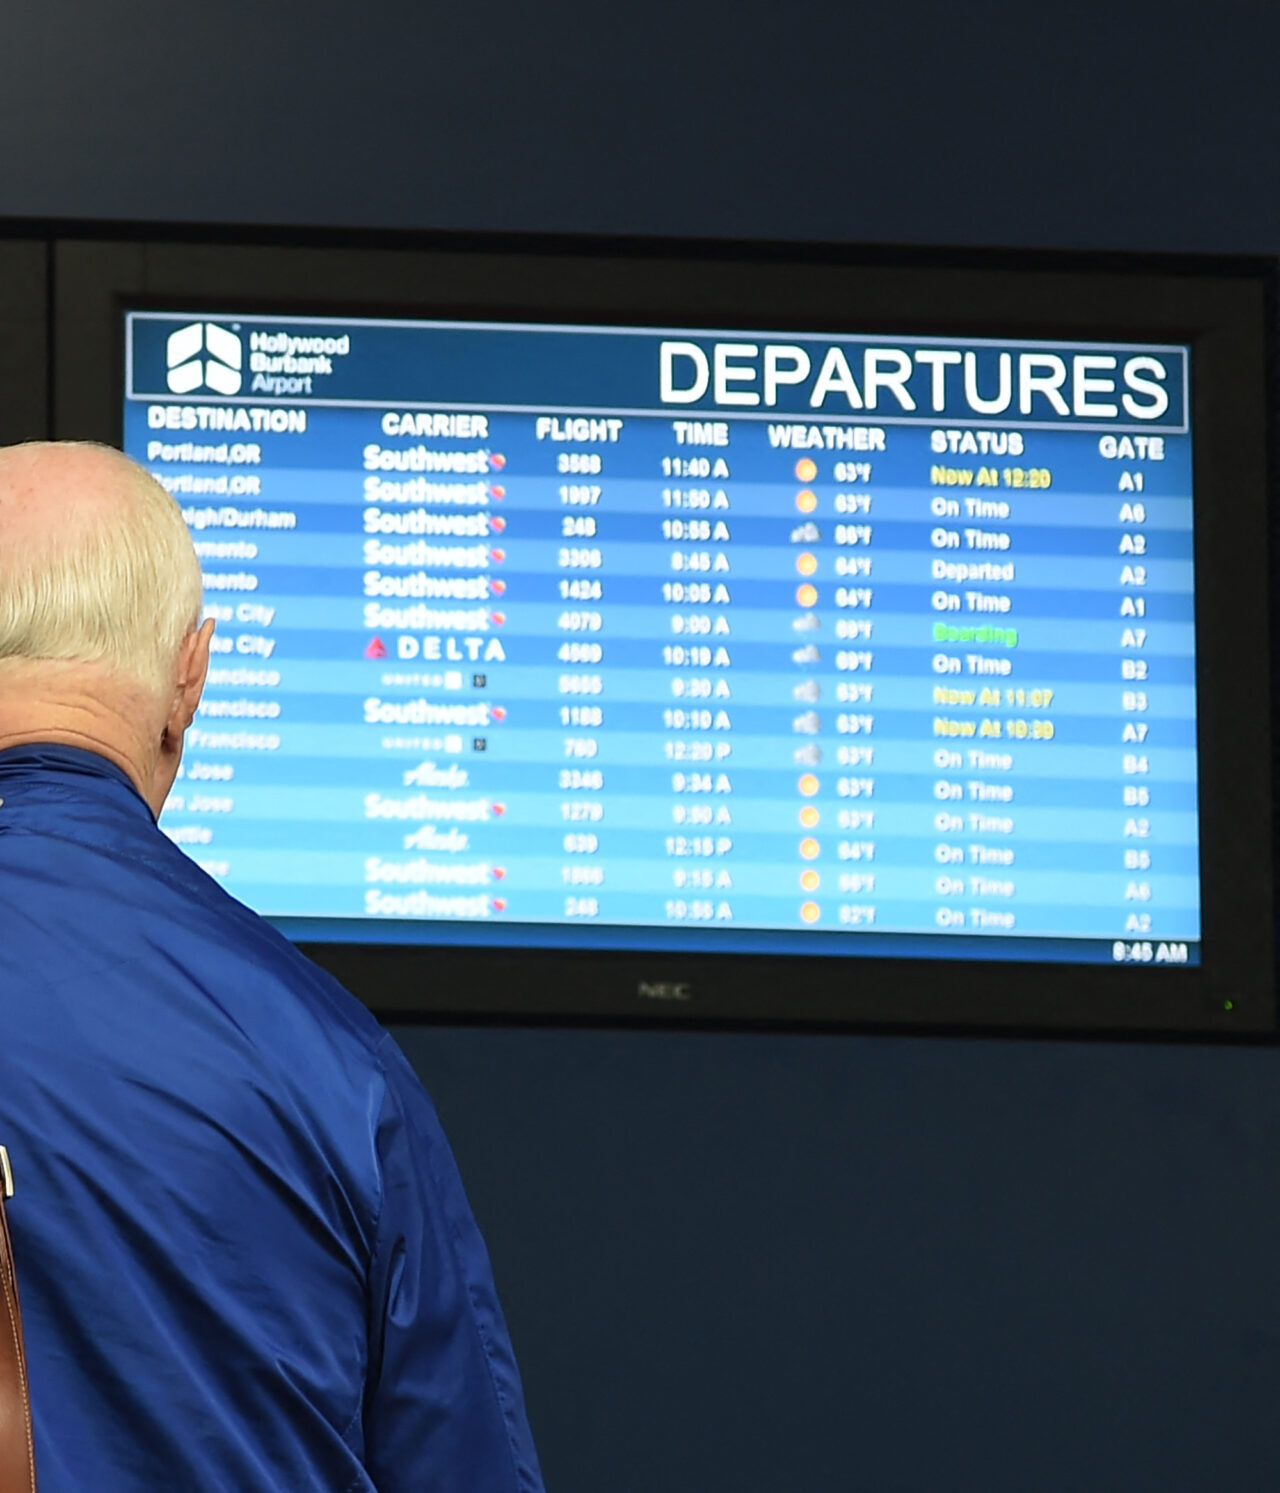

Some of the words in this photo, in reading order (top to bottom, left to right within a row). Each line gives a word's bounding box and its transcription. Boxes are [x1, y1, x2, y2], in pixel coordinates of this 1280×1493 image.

[250, 331, 350, 356] Hollywood
[250, 353, 333, 375] Burbank
[251, 373, 312, 396] Airport
[659, 341, 1170, 420] DEPARTURES
[149, 406, 305, 432] DESTINATION
[382, 413, 488, 438] CARRIER
[537, 417, 622, 441] FLIGHT
[673, 421, 728, 445] TIME
[768, 425, 885, 450] WEATHER
[931, 430, 1023, 455] STATUS
[148, 441, 261, 463] Portland,OR
[364, 444, 488, 473] Southwest
[1099, 436, 1164, 460] GATE
[713, 458, 729, 478] A
[931, 466, 973, 486] Now
[976, 467, 998, 486] At
[364, 475, 488, 505] Southwest
[1119, 472, 1142, 491] A1
[931, 497, 960, 516] On
[965, 498, 1009, 518] Time
[364, 507, 488, 536] Southwest
[931, 528, 960, 548] On
[965, 529, 1010, 550] Time
[1119, 534, 1145, 554] A2
[364, 538, 488, 568] Southwest
[932, 560, 1014, 581] Departed
[364, 570, 488, 599] Southwest
[932, 591, 961, 610] On
[966, 592, 1011, 612] Time
[1120, 597, 1144, 616] A1
[236, 603, 275, 627] City
[365, 602, 488, 631] Southwest
[934, 624, 1018, 646] Boarding
[1121, 629, 1146, 647] A7
[236, 634, 276, 659] City
[397, 635, 506, 662] DELTA
[714, 647, 730, 666] A
[932, 654, 961, 673] On
[967, 655, 1011, 675] Time
[933, 686, 975, 705] Now
[979, 687, 1000, 706] At
[365, 697, 488, 726] Southwest
[933, 718, 976, 737] Now
[979, 719, 1001, 737] At
[188, 728, 281, 750] Francisco
[934, 749, 962, 768] On
[968, 750, 1012, 770] Time
[188, 762, 234, 781] Jose
[188, 794, 234, 812] Jose
[365, 792, 488, 821] Southwest
[717, 837, 731, 854] P
[935, 844, 963, 863] On
[968, 845, 1014, 865] Time
[1112, 941, 1154, 962] 8:45
[1155, 942, 1188, 963] AM
[639, 981, 691, 1000] NEC
